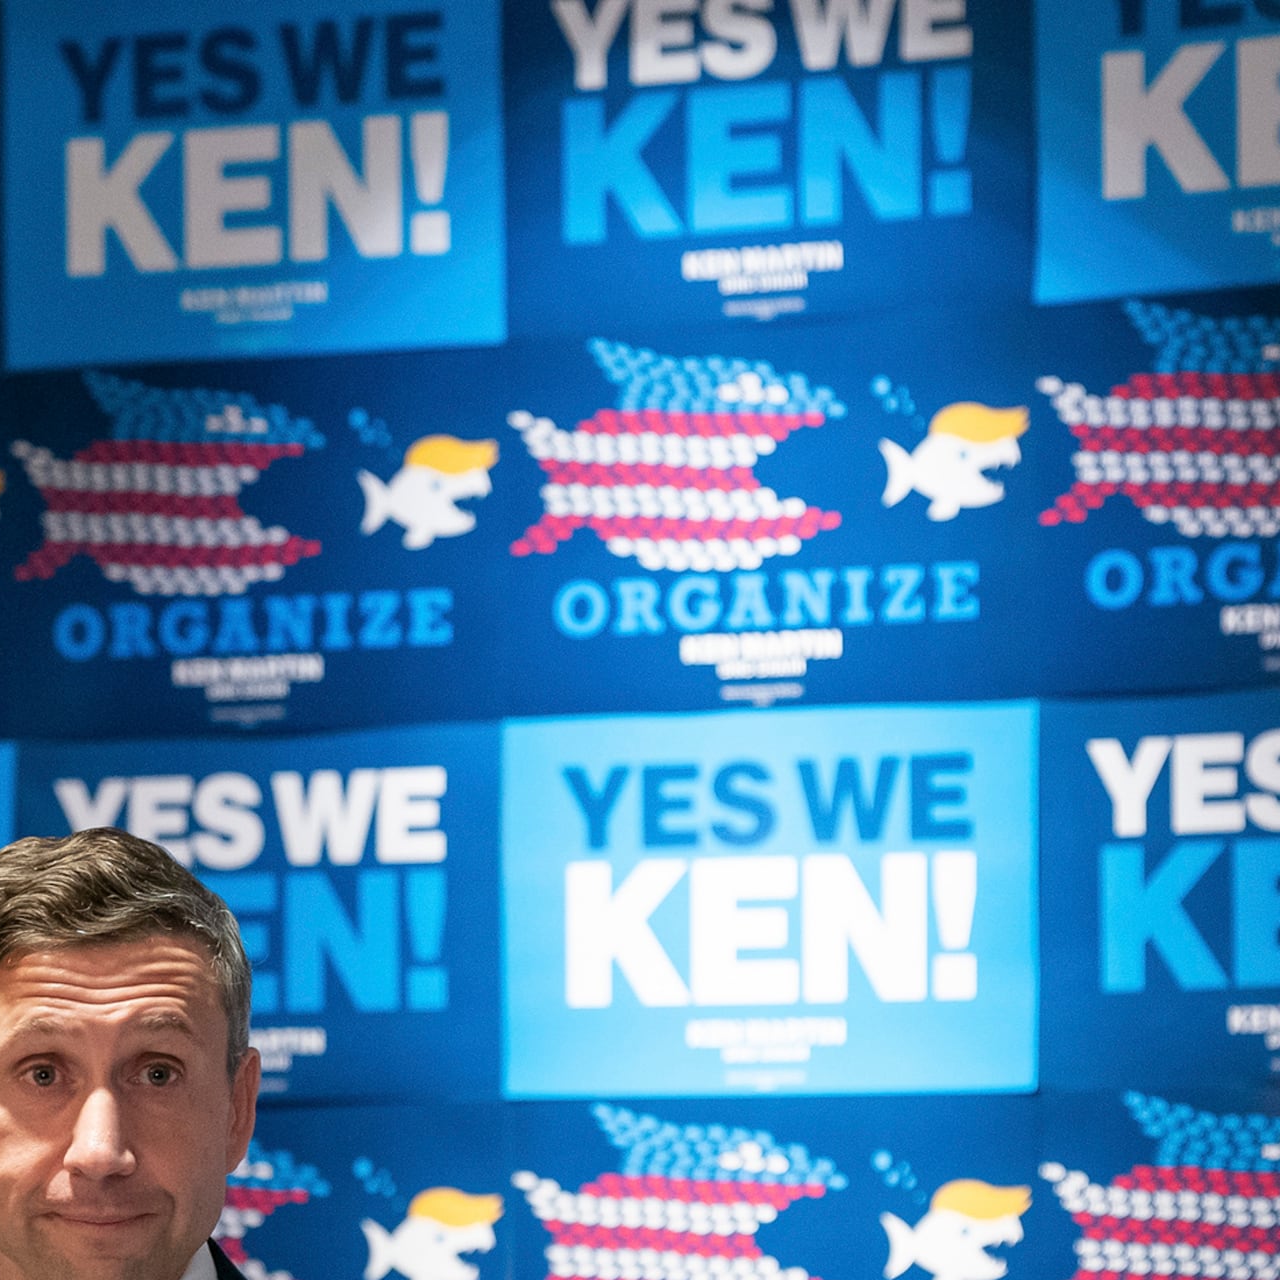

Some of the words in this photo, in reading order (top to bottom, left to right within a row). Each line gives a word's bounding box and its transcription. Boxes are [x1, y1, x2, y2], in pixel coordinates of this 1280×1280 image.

[59, 25, 261, 126] YES
[279, 11, 446, 106] WE
[552, 0, 777, 90] YES
[790, 0, 973, 72] WE
[65, 110, 451, 278] KEN!
[561, 65, 973, 246] KEN!
[52, 587, 454, 661] ORGANIZE
[552, 560, 980, 639] ORGANIZE
[1220, 604, 1280, 635] KEN
[270, 765, 447, 867] WE
[561, 761, 777, 850] YES
[797, 752, 974, 842] WE
[564, 850, 978, 1009] KEN!
